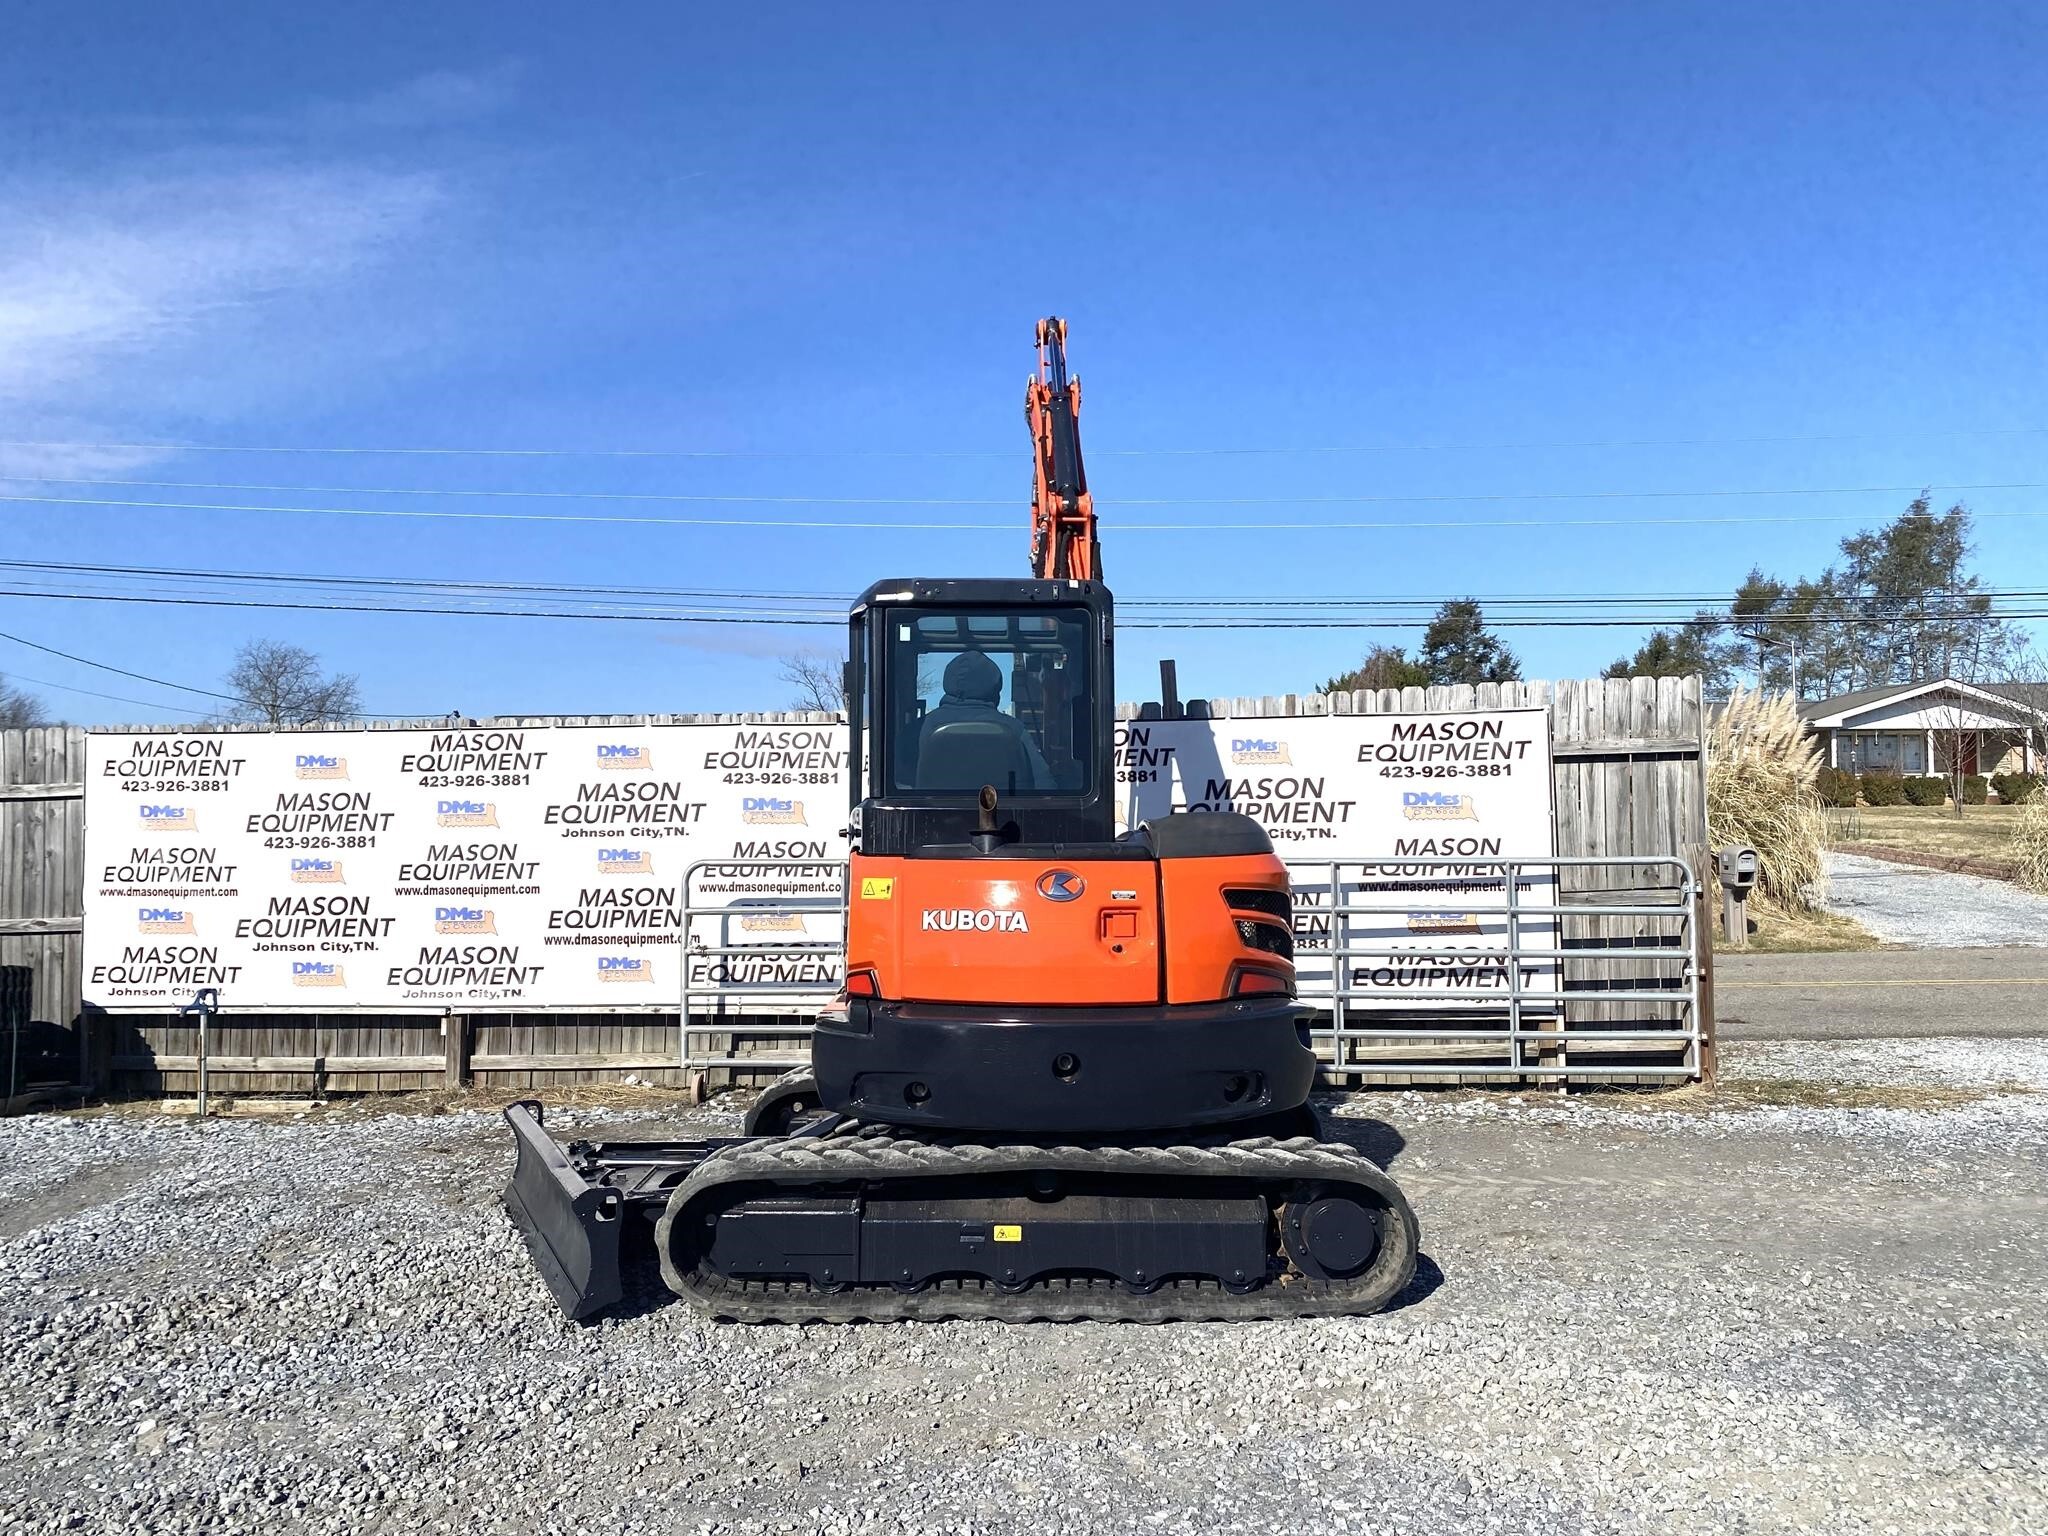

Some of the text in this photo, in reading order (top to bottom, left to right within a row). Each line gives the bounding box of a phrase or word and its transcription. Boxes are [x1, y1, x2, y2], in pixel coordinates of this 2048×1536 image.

[1392, 721, 1503, 741] MASON
[133, 740, 223, 757] MASON
[431, 734, 524, 752] MASON
[735, 732, 832, 749] MASON
[1358, 741, 1532, 762] EQUIPMENT
[103, 760, 246, 776] EQUIPMENT
[401, 753, 547, 772] EQUIPMENT
[1380, 764, 1511, 778] 423-926-3881
[122, 781, 228, 791] 423-926-3881
[419, 775, 529, 787] 423-926-3881
[723, 773, 838, 784] 423-926-3881
[577, 783, 680, 802] MASON
[1205, 778, 1324, 800] MASON
[276, 793, 370, 811] MASON
[246, 813, 394, 832] EQUIPMENT
[544, 804, 707, 824] EQUIPMENT
[562, 829, 624, 837] Johnson
[264, 836, 375, 848] 423-926-3881
[733, 842, 826, 858] MASON
[1395, 838, 1501, 856] MASON
[131, 848, 216, 864] MASON
[427, 844, 517, 861] MASON
[104, 866, 237, 882] EQUIPMENT
[399, 863, 540, 881] EQUIPMENT
[100, 887, 238, 898] www.dmasonequipment.com
[395, 885, 540, 897] www.dmasonequipment.com
[700, 882, 841, 894] www.dmasonequipment.co
[1358, 880, 1531, 893] www.dmasonequipment.om
[579, 888, 675, 907] MASON
[268, 897, 370, 916] MASON
[235, 918, 395, 938] EQUIPMENT
[922, 909, 1028, 932] KUBOTA
[122, 947, 217, 963] MASON
[253, 943, 314, 951] Johnson
[419, 947, 519, 964] MASON
[91, 967, 242, 983] EQUIPMENT
[387, 967, 544, 985] EQUIPMENT
[108, 988, 166, 996] Johnson
[403, 990, 462, 998] Johnson
